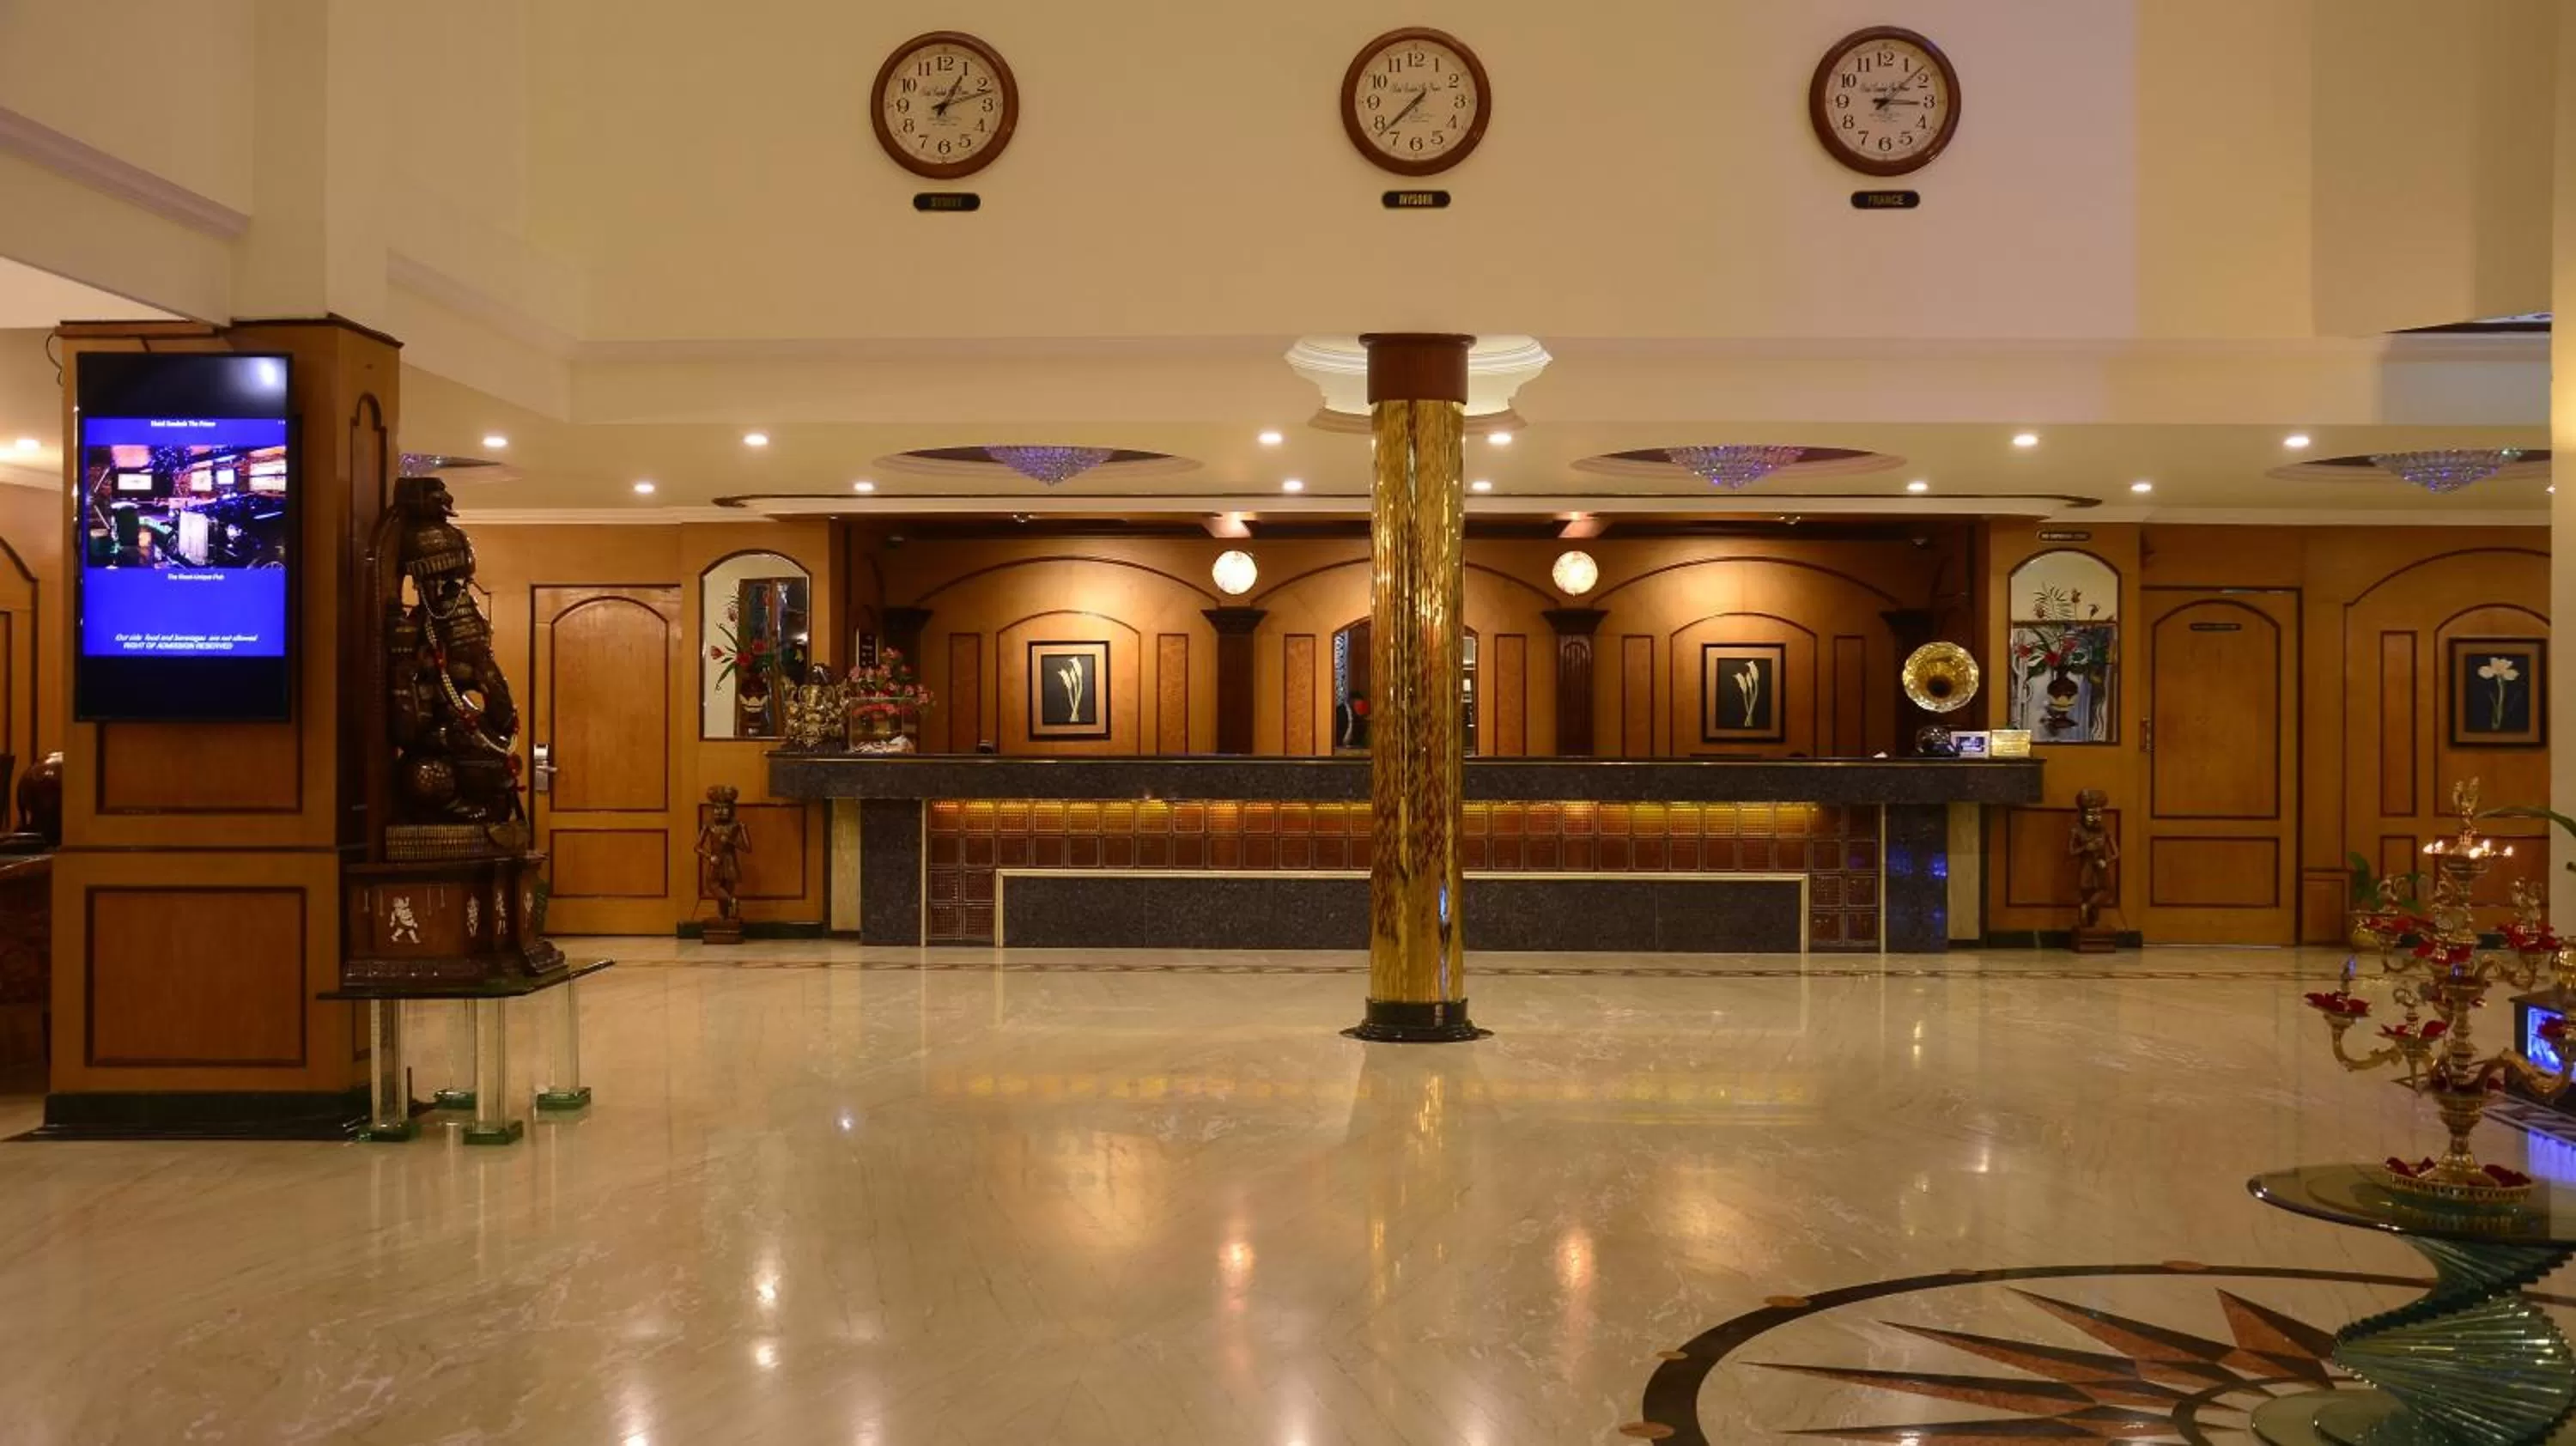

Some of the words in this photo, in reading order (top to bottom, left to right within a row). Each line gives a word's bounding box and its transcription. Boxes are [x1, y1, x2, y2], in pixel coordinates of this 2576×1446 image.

[937, 57, 954, 71] 12
[1388, 58, 1400, 73] 11
[1406, 52, 1425, 67] 12
[1434, 58, 1440, 73] 1
[1856, 58, 1870, 73] 11
[1876, 52, 1894, 66] 12
[1904, 58, 1909, 72] 1
[918, 62, 930, 76] 11
[963, 62, 969, 76] 1
[902, 78, 917, 93] 10
[977, 77, 988, 92] 2
[1373, 75, 1388, 89] 10
[1449, 73, 1460, 88] 2
[1841, 74, 1856, 88] 10
[1917, 75, 1929, 88] 2
[896, 99, 909, 114] 9
[982, 98, 993, 112] 3
[1366, 95, 1380, 110] 9
[1454, 94, 1466, 109] 3
[1836, 94, 1849, 109] 9
[1923, 94, 1935, 109] 3
[902, 119, 914, 134] 8
[975, 118, 985, 132] 4
[1374, 115, 1385, 131] 8
[1447, 114, 1457, 129] 4
[1842, 115, 1855, 130] 8
[1917, 115, 1926, 129] 4
[918, 135, 928, 149] 7
[958, 135, 971, 149] 5
[1389, 131, 1400, 146] 7
[1410, 137, 1423, 151] 6
[1431, 131, 1443, 144] 5
[1858, 131, 1868, 146] 7
[1878, 137, 1892, 151] 6
[1899, 131, 1913, 145] 5
[938, 139, 951, 155] 6
[1868, 194, 1905, 205] FRANCE
